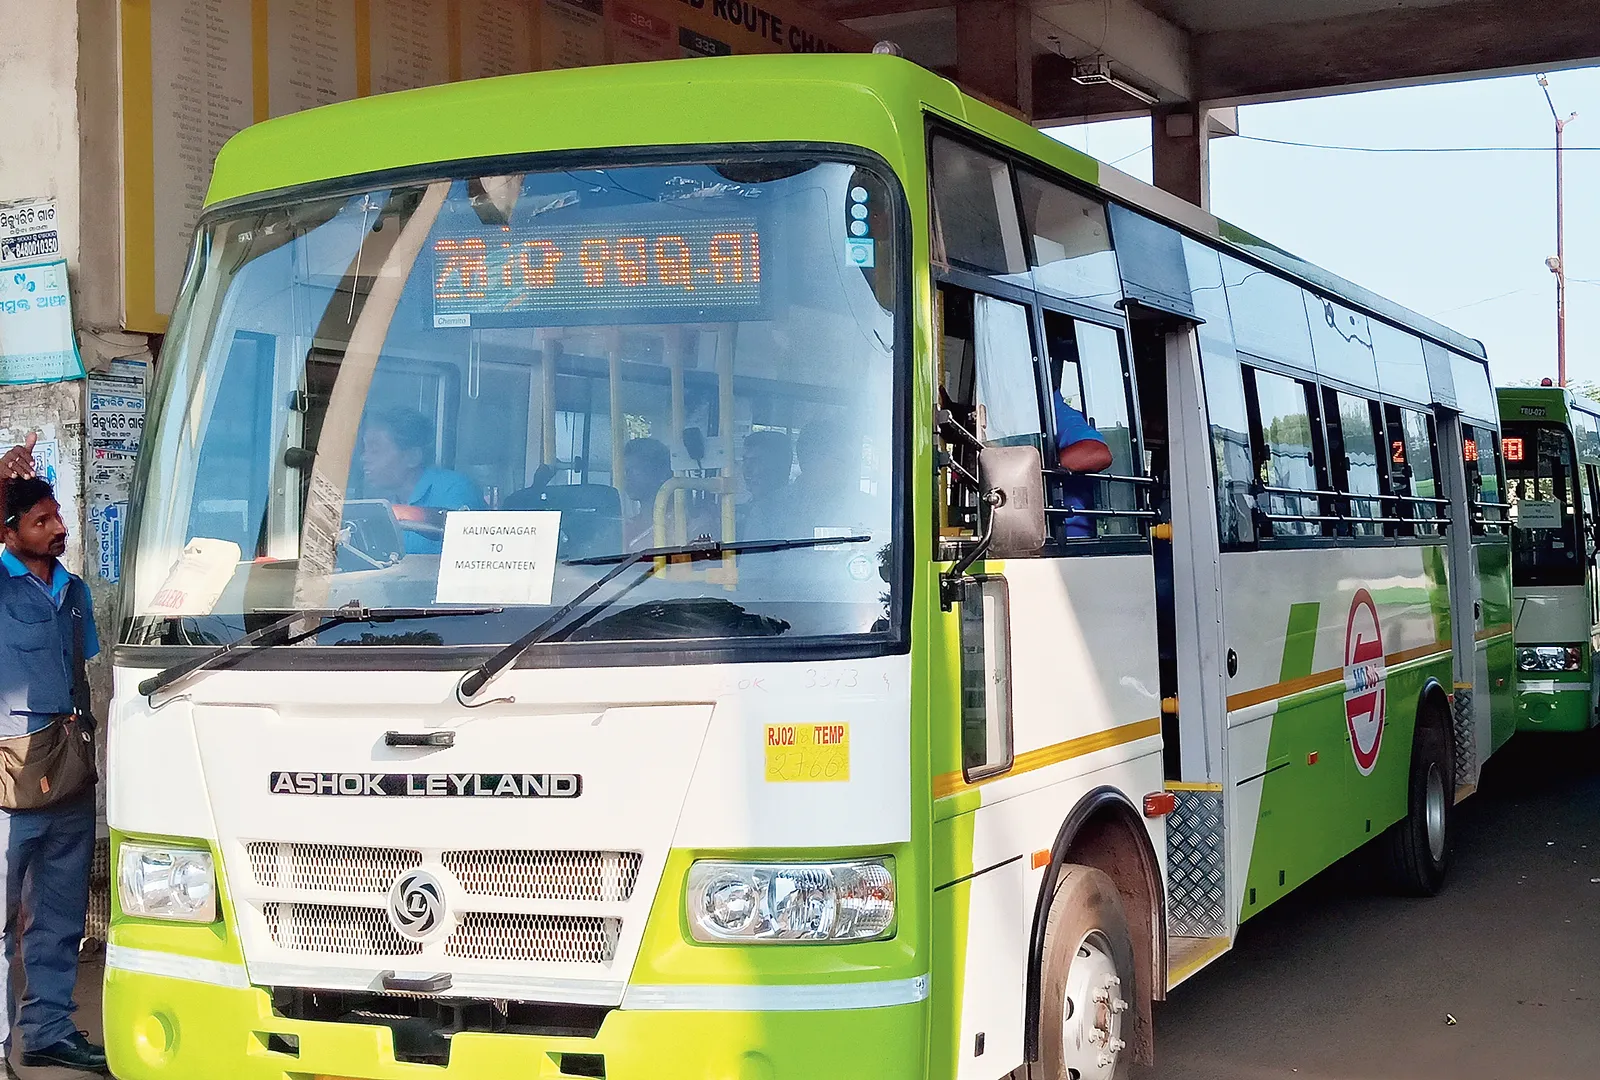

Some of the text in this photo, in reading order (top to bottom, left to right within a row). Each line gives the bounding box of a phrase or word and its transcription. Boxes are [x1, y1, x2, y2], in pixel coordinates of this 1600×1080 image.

[712, 0, 783, 45] ROUTE
[695, 37, 717, 54] 333
[462, 526, 537, 536] KALINGANAGAR
[490, 543, 504, 553] TO
[454, 560, 536, 570] MASTERCANTEEN
[273, 772, 578, 797] ASHOK LEYLAND
